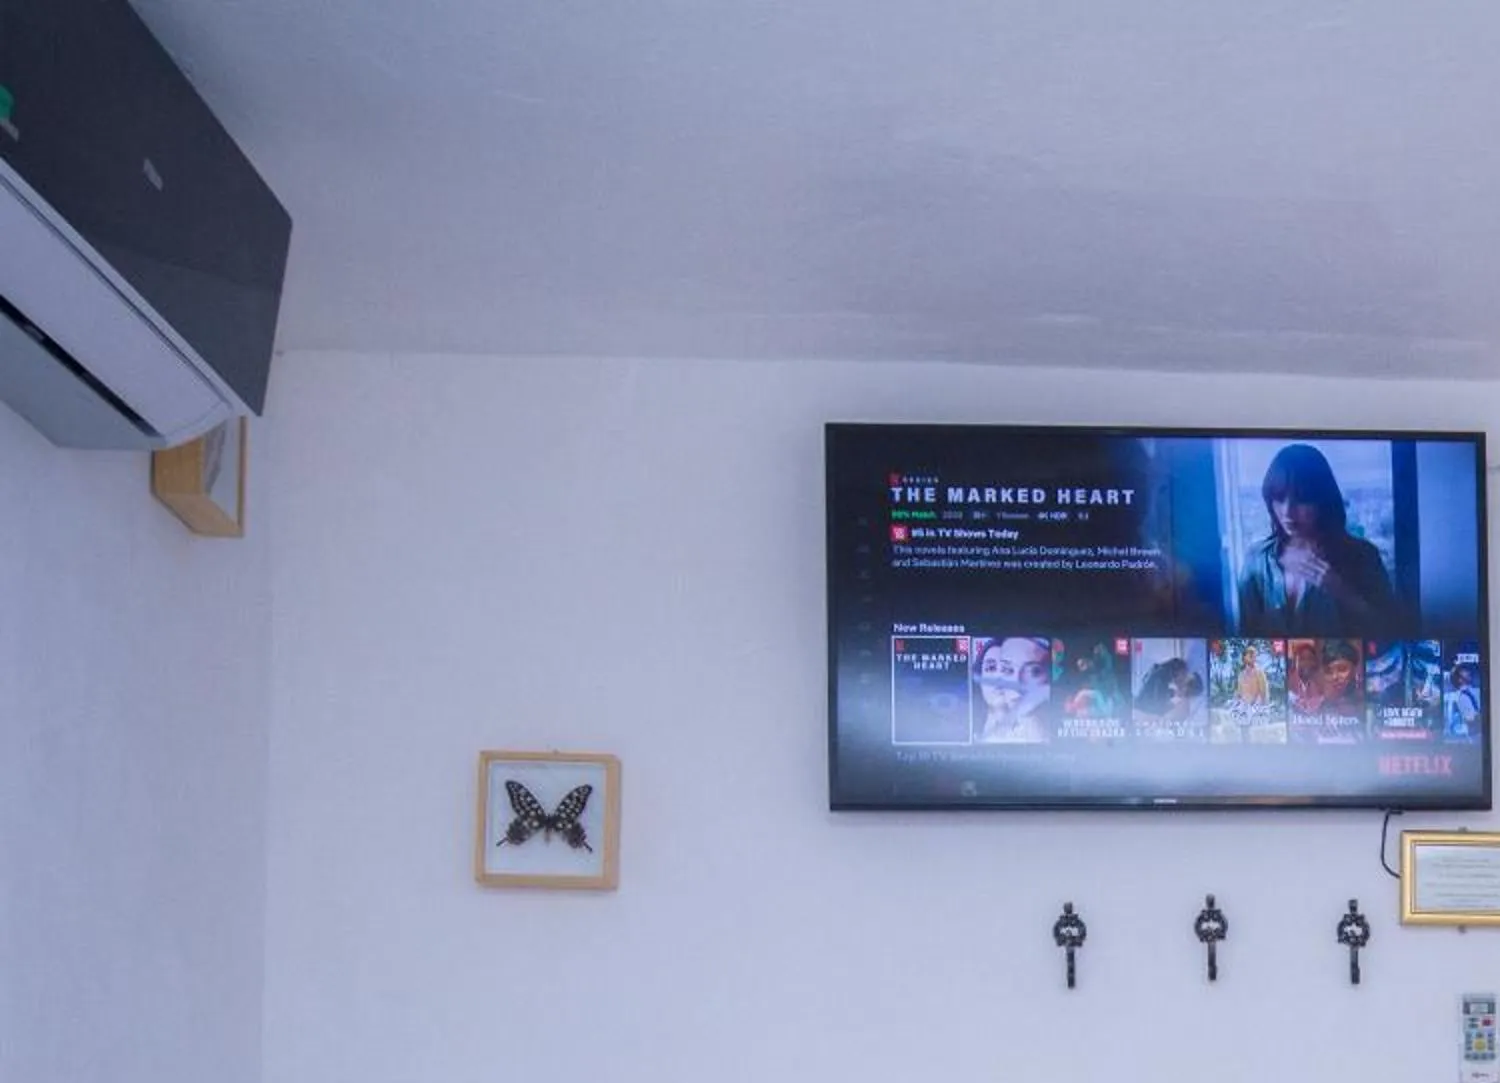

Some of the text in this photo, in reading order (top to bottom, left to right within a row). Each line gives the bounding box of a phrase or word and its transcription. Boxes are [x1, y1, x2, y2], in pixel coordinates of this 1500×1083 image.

[891, 487, 1135, 505] THE MARKED HEART
[938, 527, 952, 537] TV
[953, 527, 987, 539] Shows
[987, 528, 1019, 540] Today
[893, 624, 965, 633] New Releases
[1378, 756, 1452, 775] NETFLIX
